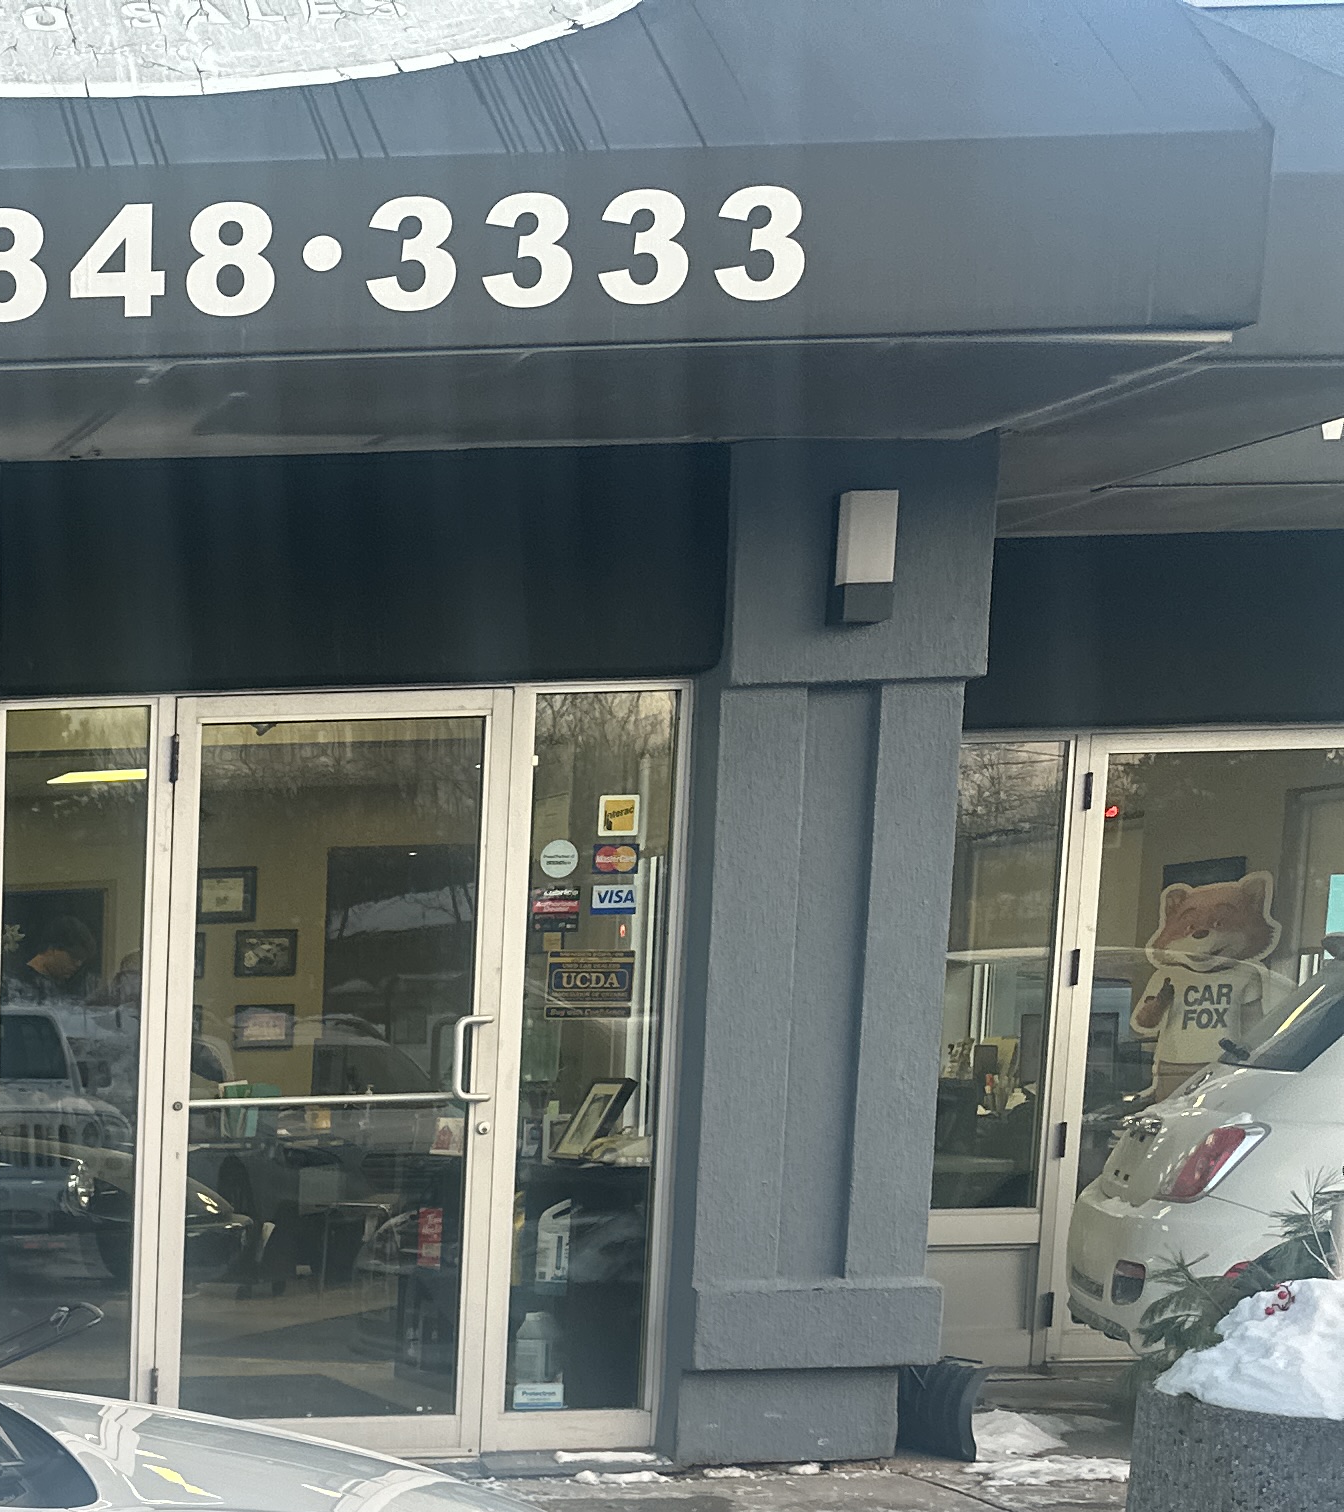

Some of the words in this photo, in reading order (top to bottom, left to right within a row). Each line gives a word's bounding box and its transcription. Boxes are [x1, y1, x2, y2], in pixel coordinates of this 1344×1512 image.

[597, 889, 635, 904] VISA
[561, 972, 620, 988] UCDA
[1183, 984, 1233, 1007] CAR
[1182, 1008, 1229, 1030] FOX
